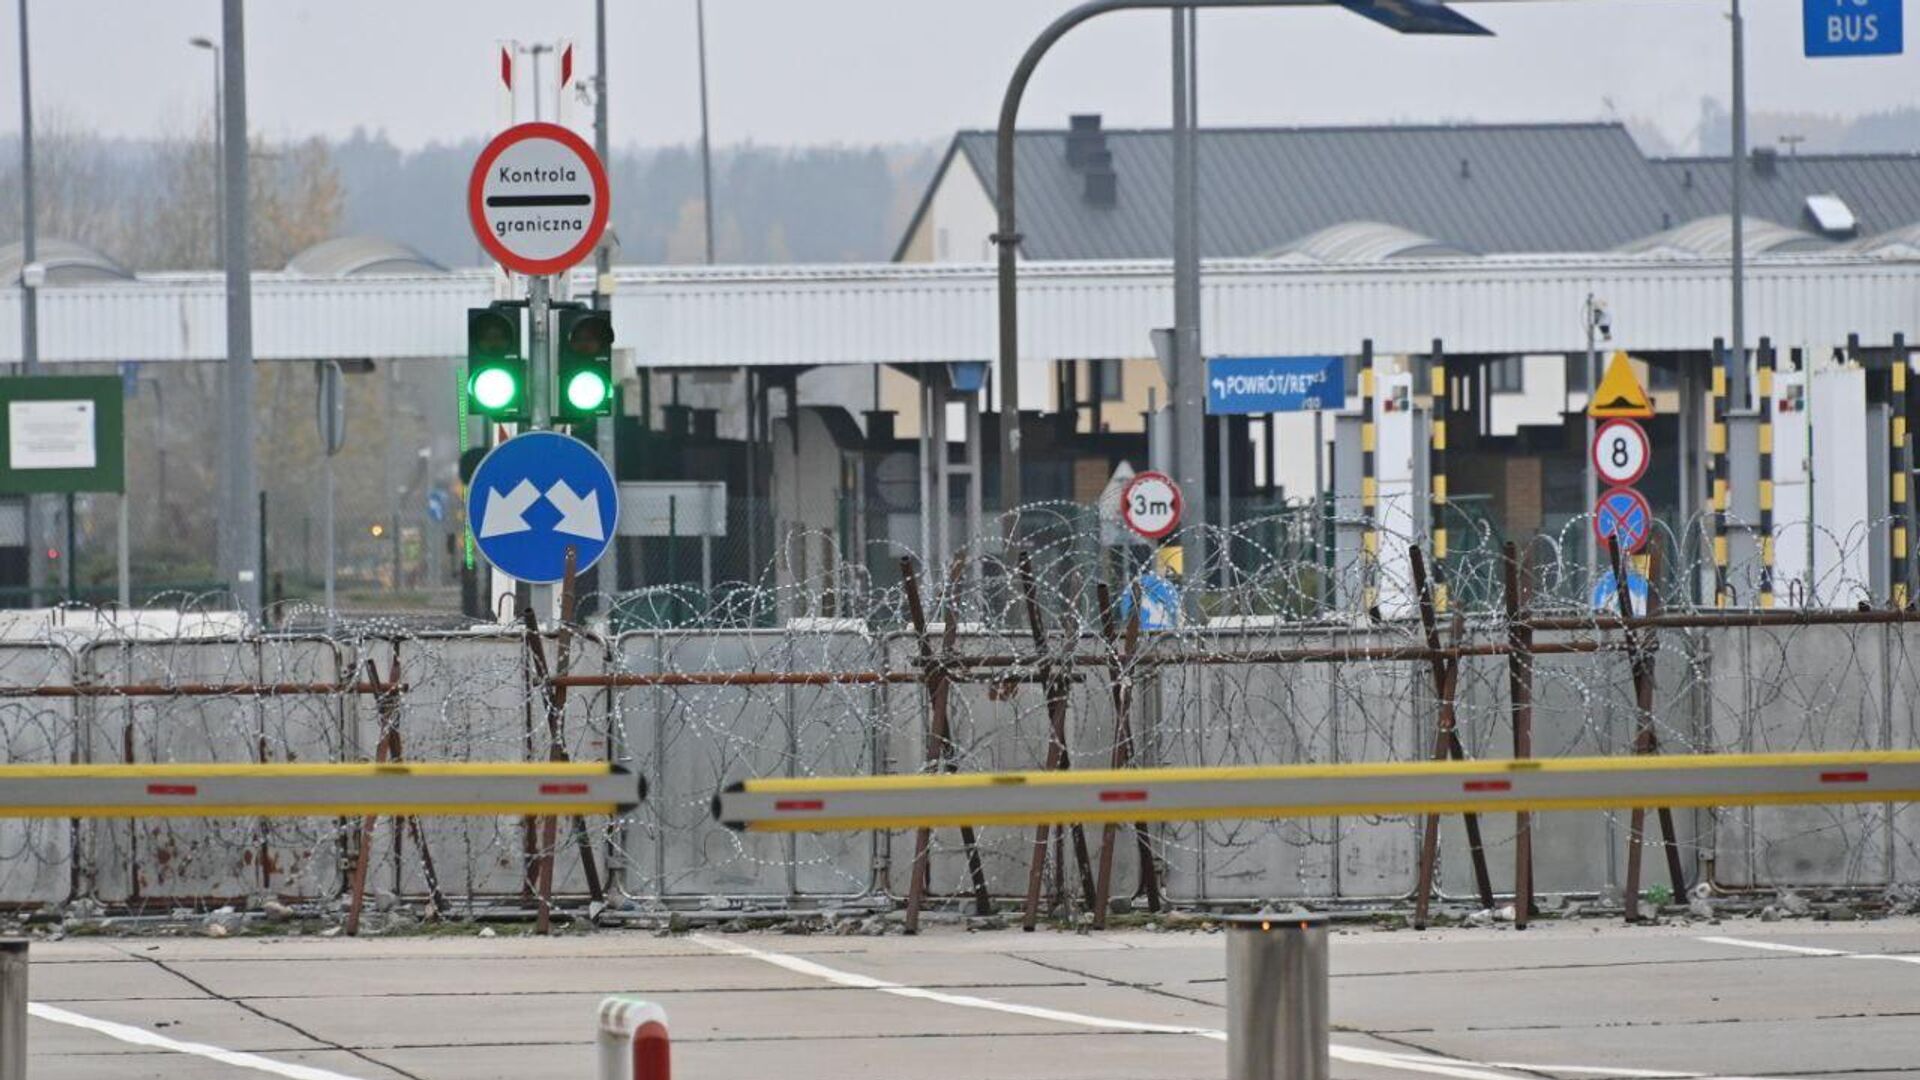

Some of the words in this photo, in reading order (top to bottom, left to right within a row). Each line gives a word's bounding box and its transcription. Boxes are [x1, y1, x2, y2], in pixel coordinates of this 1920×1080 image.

[1828, 15, 1879, 42] BUS
[500, 166, 576, 182] Kontrola
[496, 216, 582, 236] graniczna
[1612, 437, 1628, 468] 8
